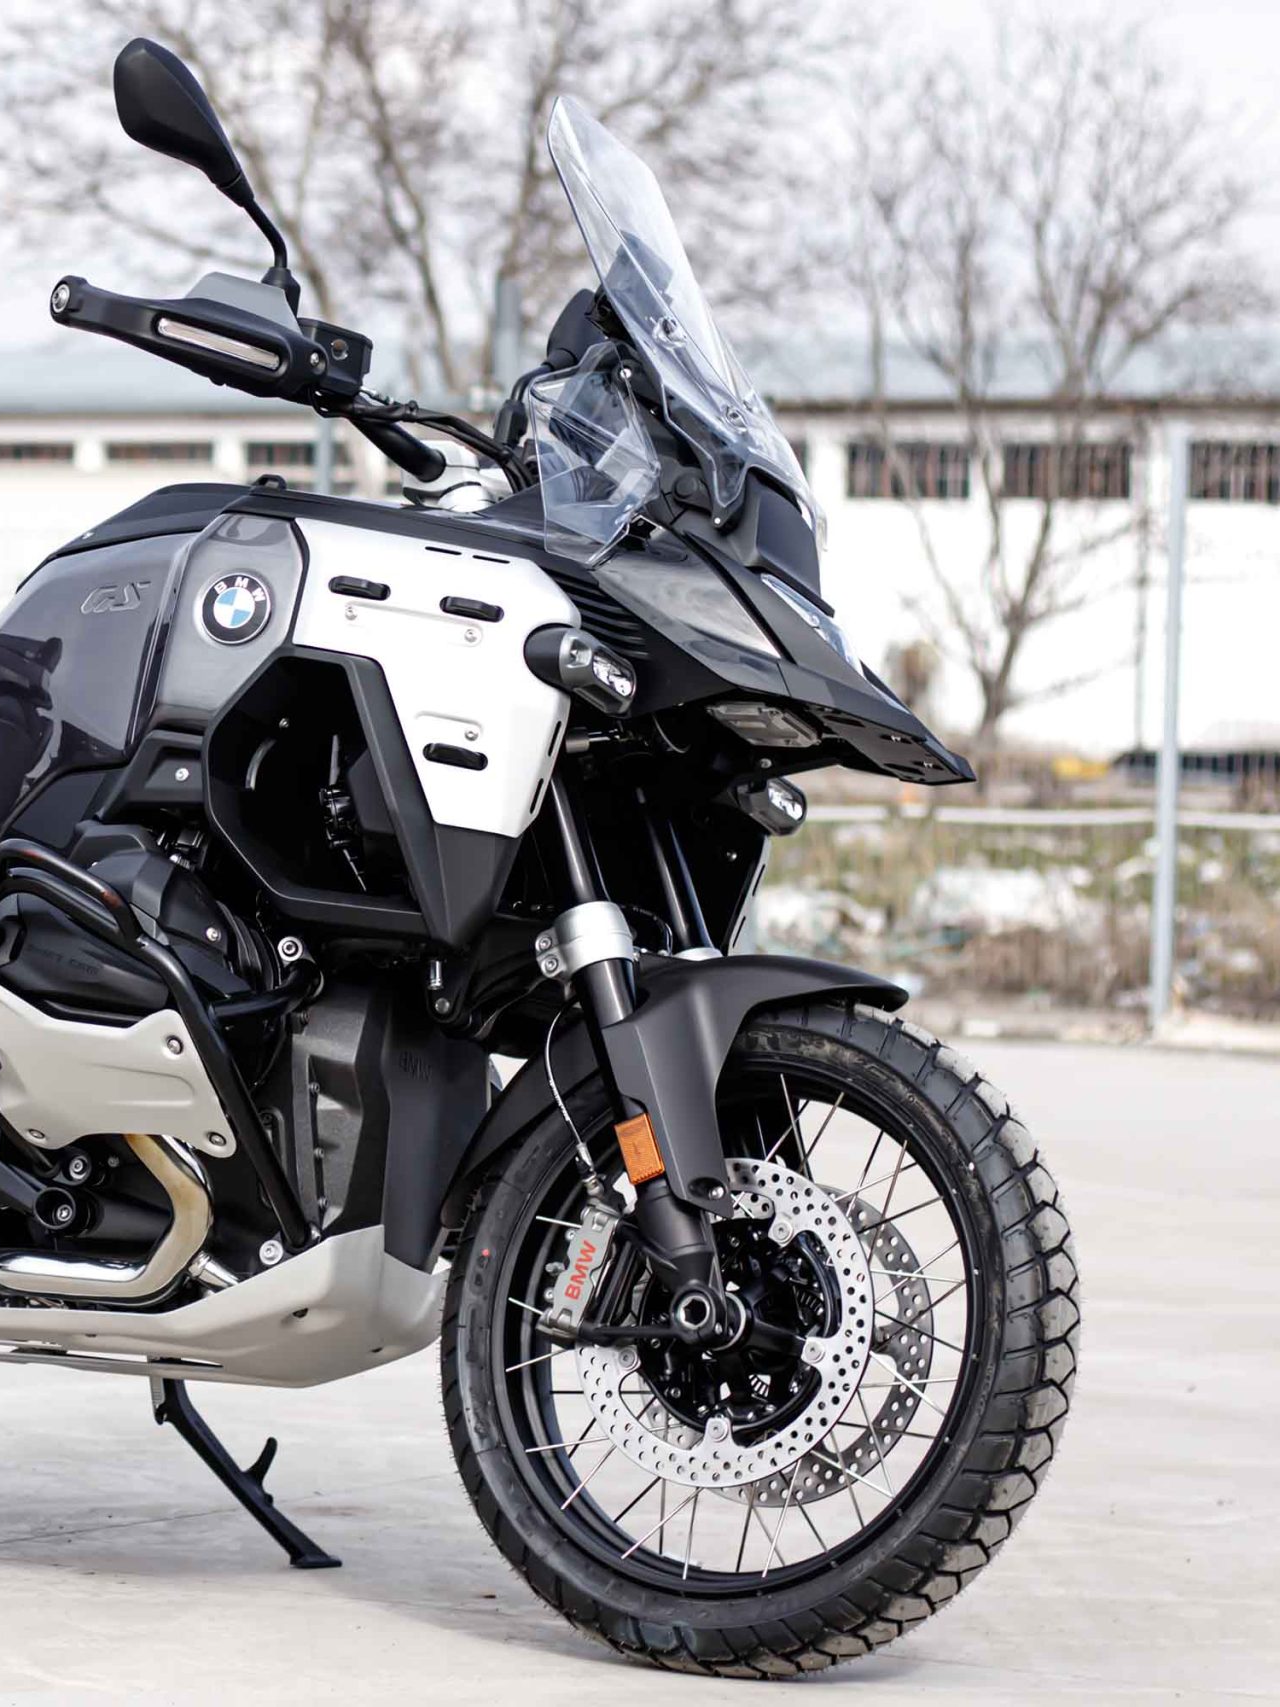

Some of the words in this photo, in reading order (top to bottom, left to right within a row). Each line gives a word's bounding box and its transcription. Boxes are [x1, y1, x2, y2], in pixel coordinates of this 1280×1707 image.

[81, 581, 151, 615] GS
[214, 576, 266, 602] BMW
[564, 1240, 597, 1300] BMW
